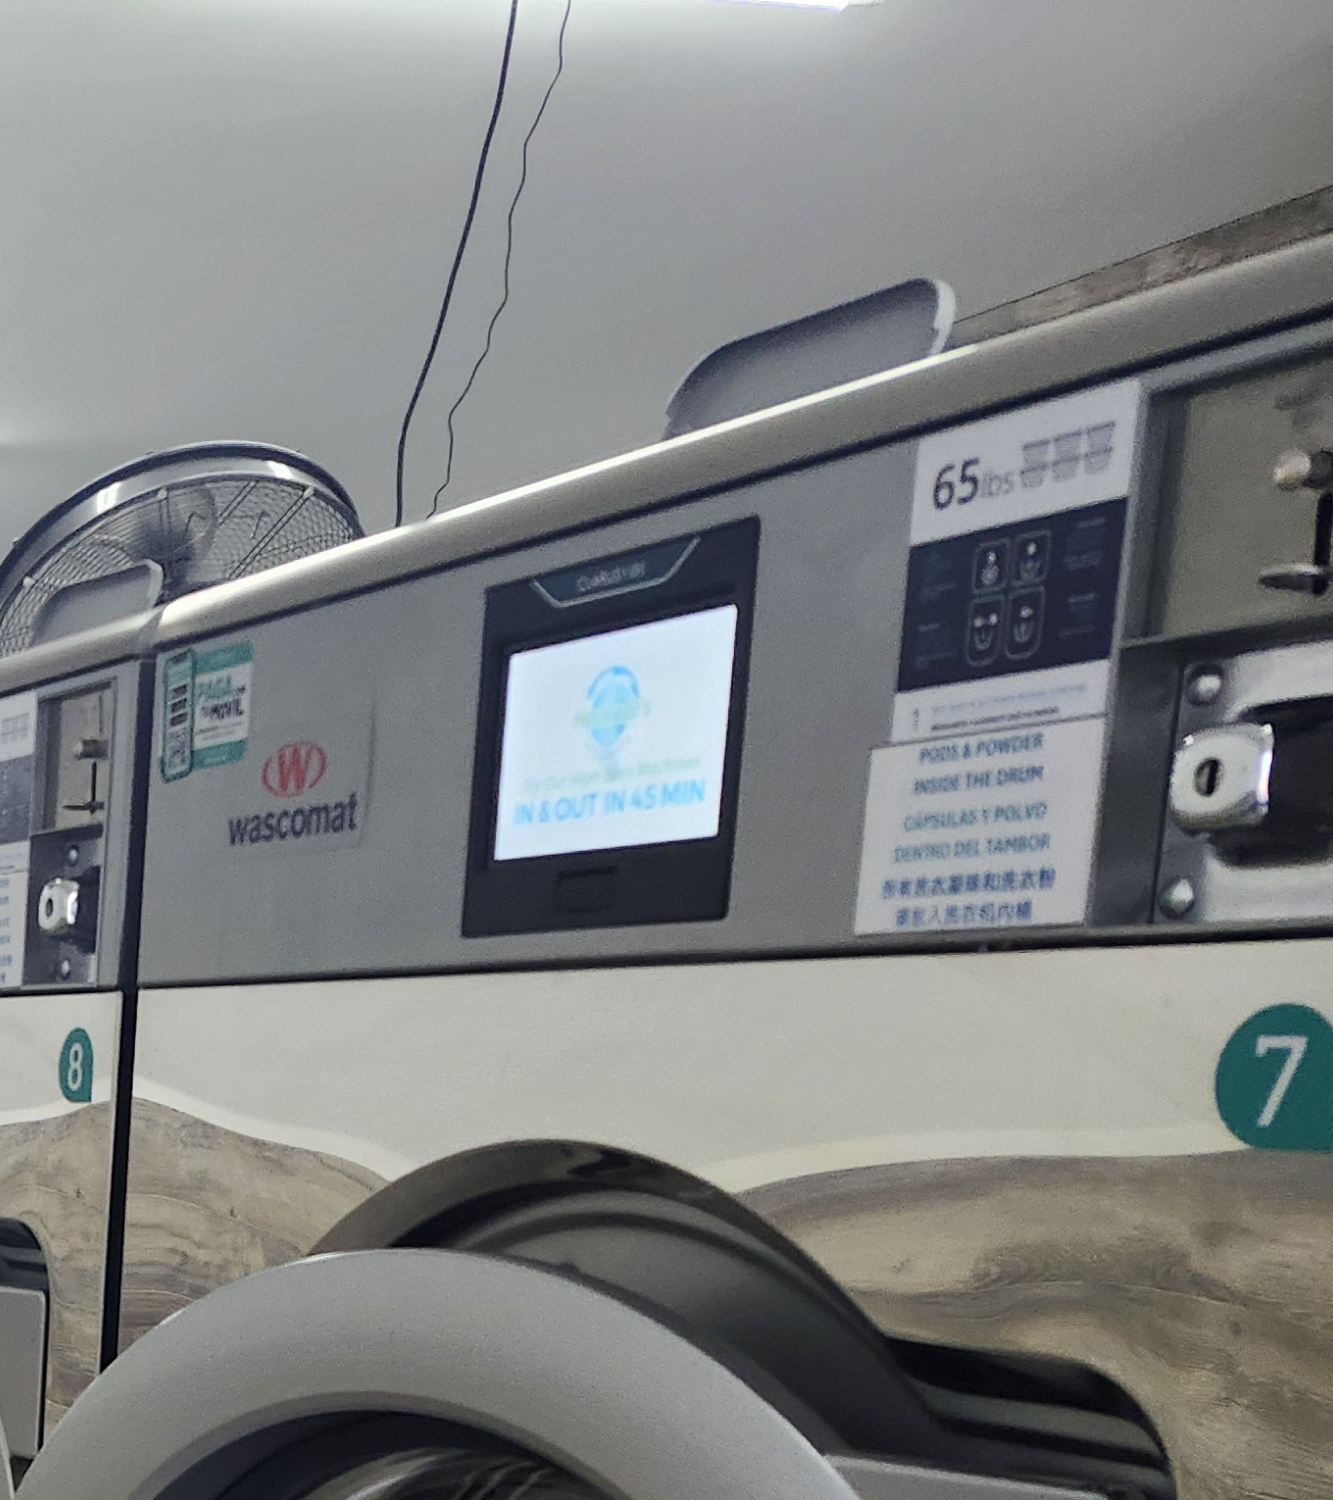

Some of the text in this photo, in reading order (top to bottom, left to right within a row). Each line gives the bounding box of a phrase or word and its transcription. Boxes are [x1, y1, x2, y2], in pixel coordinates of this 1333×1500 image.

[228, 791, 358, 847] wascomat
[513, 778, 706, 826] IN & OUT IN 45 MIN
[68, 1042, 83, 1091] 8
[1255, 1034, 1310, 1127] 7
